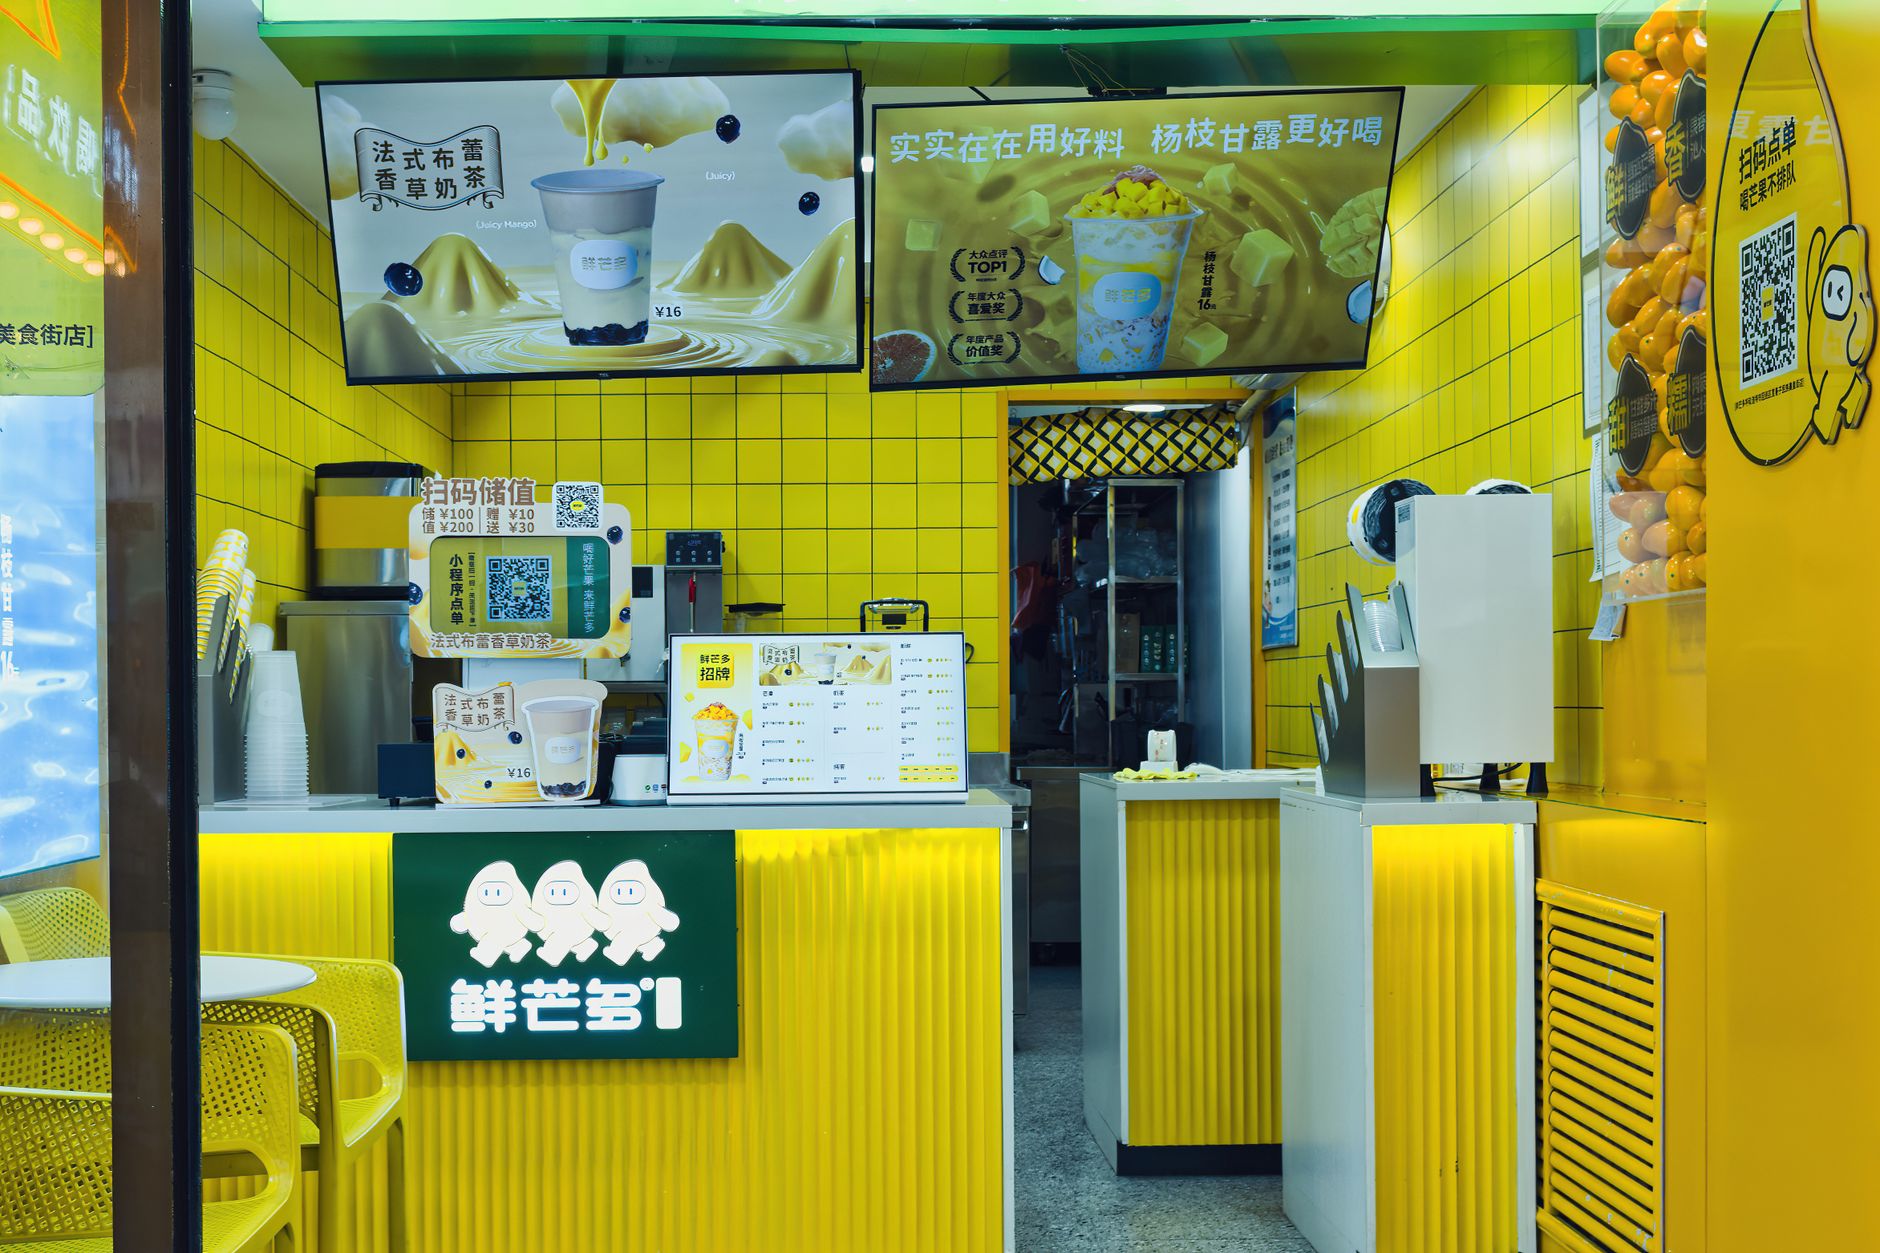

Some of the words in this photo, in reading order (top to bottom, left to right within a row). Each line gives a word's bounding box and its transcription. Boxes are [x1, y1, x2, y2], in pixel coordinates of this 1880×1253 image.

[889, 123, 1124, 163] 实实在在用好料
[1151, 113, 1384, 153] 杨枝甘露更好喝
[372, 137, 484, 172] 法式布蕾
[1739, 116, 1797, 184] 扫码点单
[705, 170, 736, 181] (Juicy)
[374, 166, 486, 201] 香草奶茶
[1740, 160, 1797, 211] 喝芒果不排队
[476, 220, 501, 231] (Juicy
[503, 220, 538, 230] Mango)
[969, 249, 1008, 260] 大众点评
[968, 261, 1007, 273] TOP1
[1201, 251, 1217, 298] 杨枝甘露
[968, 291, 1006, 302] 年度大众
[655, 305, 682, 318] ¥16
[968, 302, 1006, 315] 喜爱奖
[966, 334, 1005, 345] 年度产品
[965, 345, 1004, 357] 价值奖
[422, 477, 536, 507] 扫码储值
[440, 508, 474, 520] ¥100
[508, 508, 535, 520] ¥10
[422, 521, 435, 534] 值
[440, 521, 474, 533] ¥200
[486, 521, 500, 534] 送
[508, 521, 535, 533] ¥30
[449, 553, 464, 625] 小程序点单
[430, 632, 551, 649] 法式布蕾香草奶茶
[700, 653, 731, 664] 鲜芒多
[700, 666, 731, 681] 招牌
[444, 707, 505, 726] 香草奶茶
[507, 767, 531, 778] ¥16
